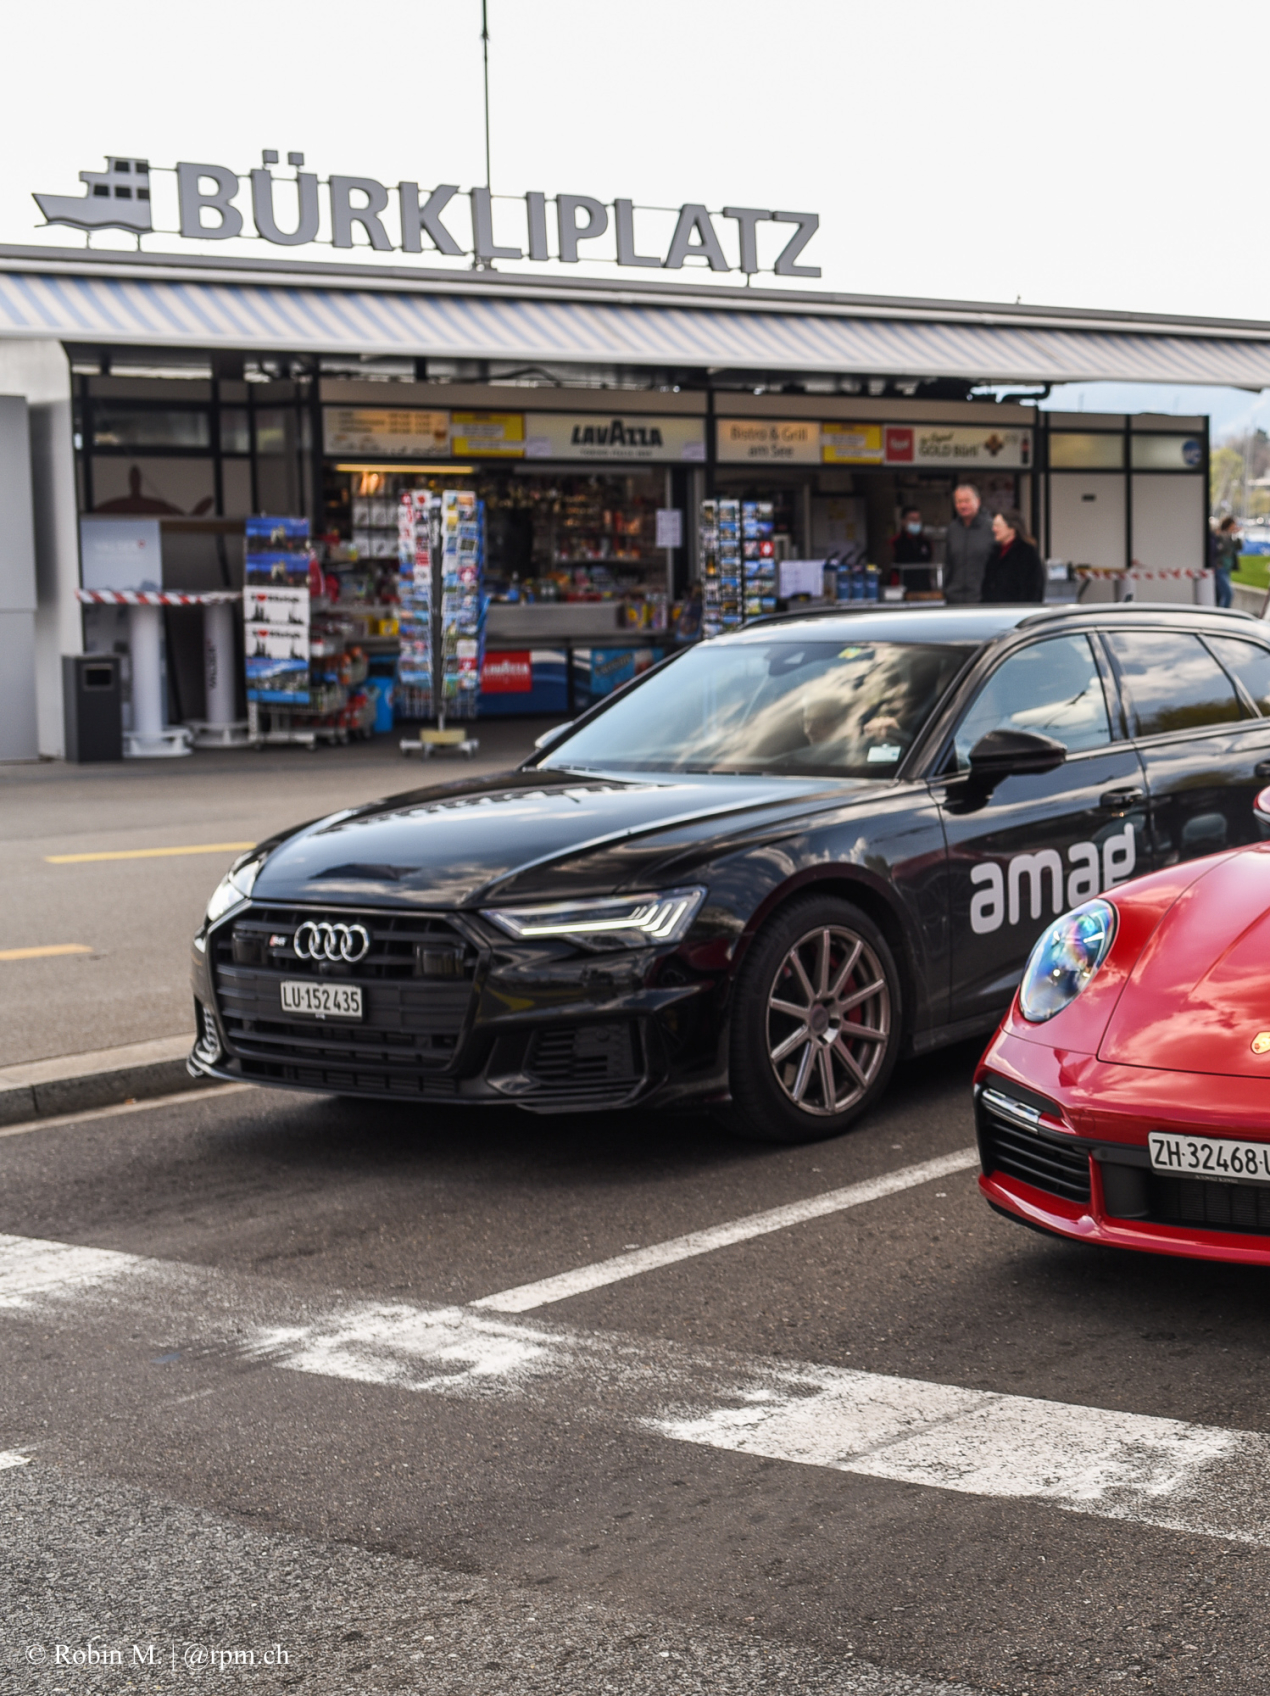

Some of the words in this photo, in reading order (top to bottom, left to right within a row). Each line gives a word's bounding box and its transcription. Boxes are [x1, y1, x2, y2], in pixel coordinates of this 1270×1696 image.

[177, 149, 822, 279] BÜRKLIPLATZ
[571, 419, 664, 447] LAVAZZA
[730, 427, 768, 441] Bistro
[782, 427, 808, 441] Grill
